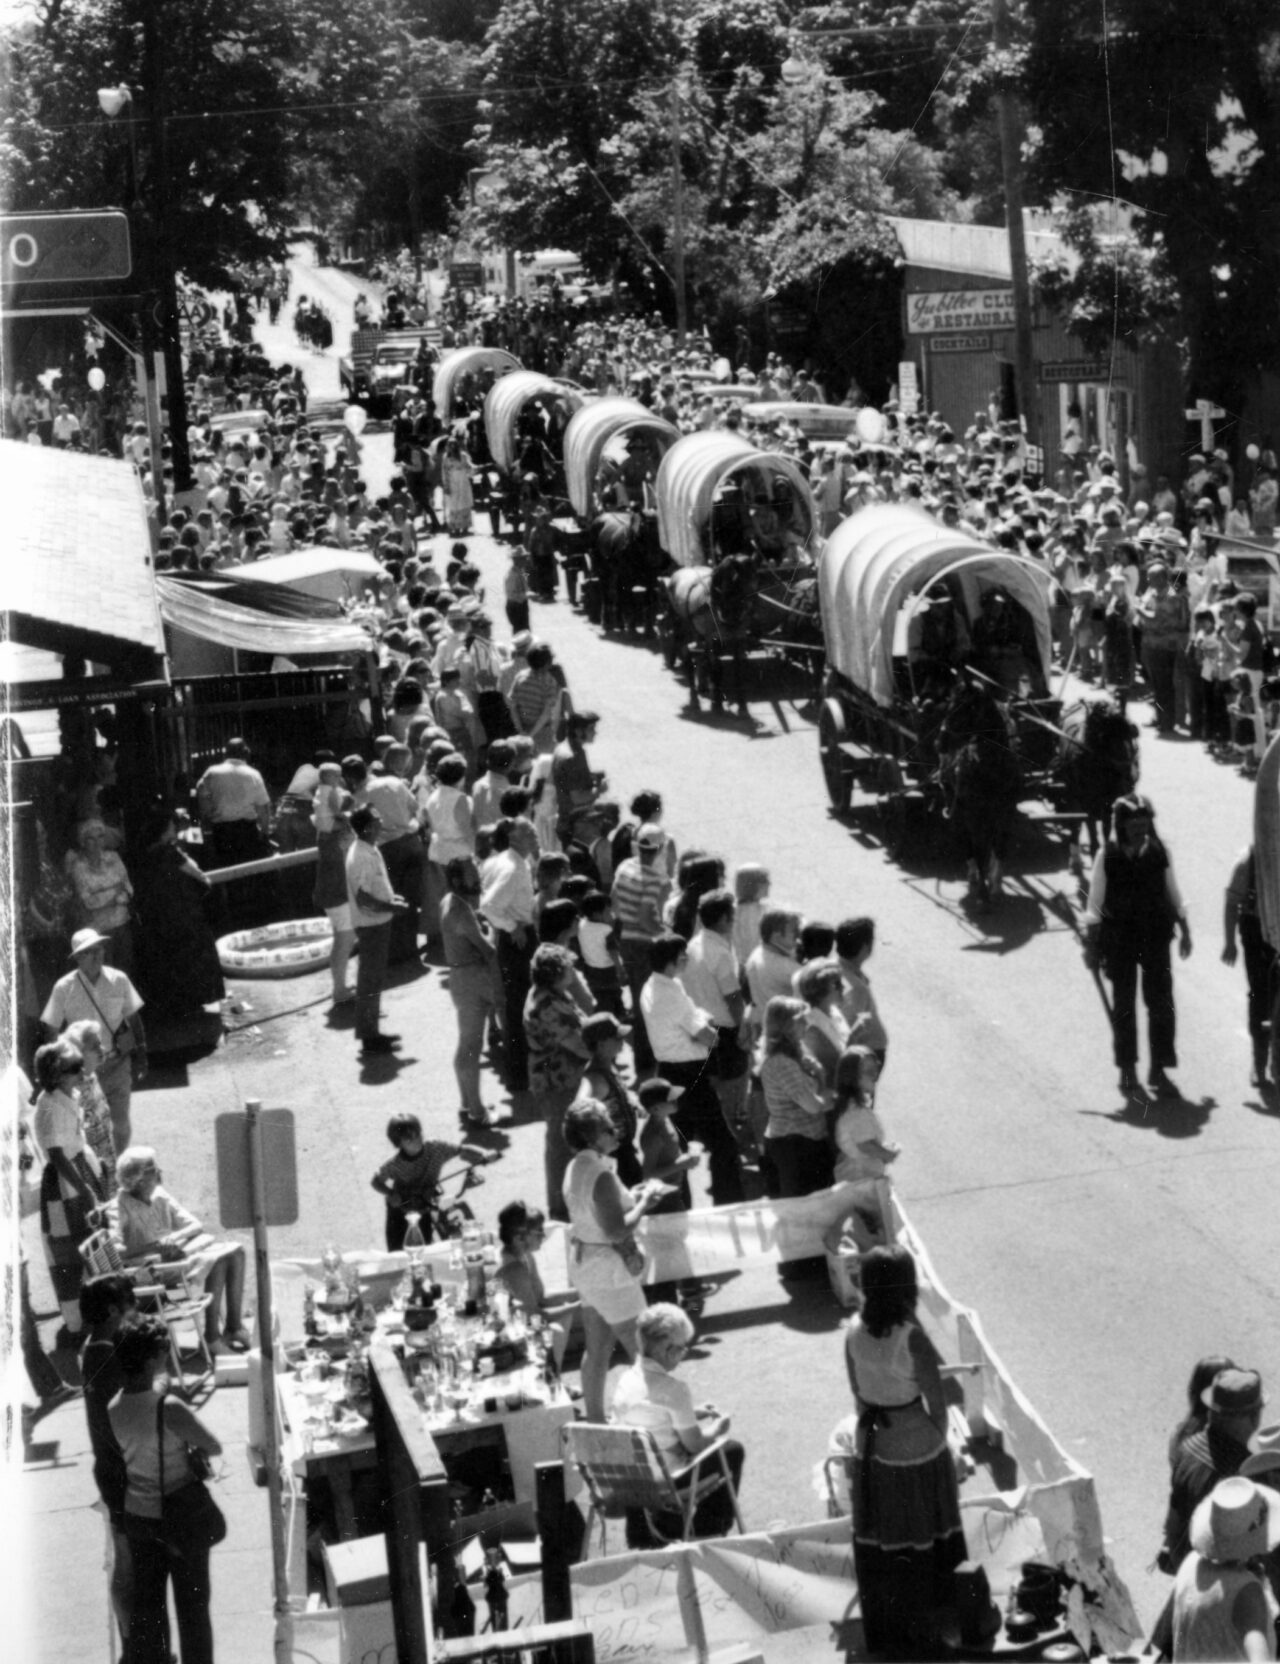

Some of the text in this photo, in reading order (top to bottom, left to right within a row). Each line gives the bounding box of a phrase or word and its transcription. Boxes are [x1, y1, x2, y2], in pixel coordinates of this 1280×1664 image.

[911, 292, 1015, 323] Jubilee CLU
[934, 311, 1016, 328] RESTAURA
[934, 337, 987, 350] COCKTAILS
[86, 690, 138, 701] ASSOCIATION
